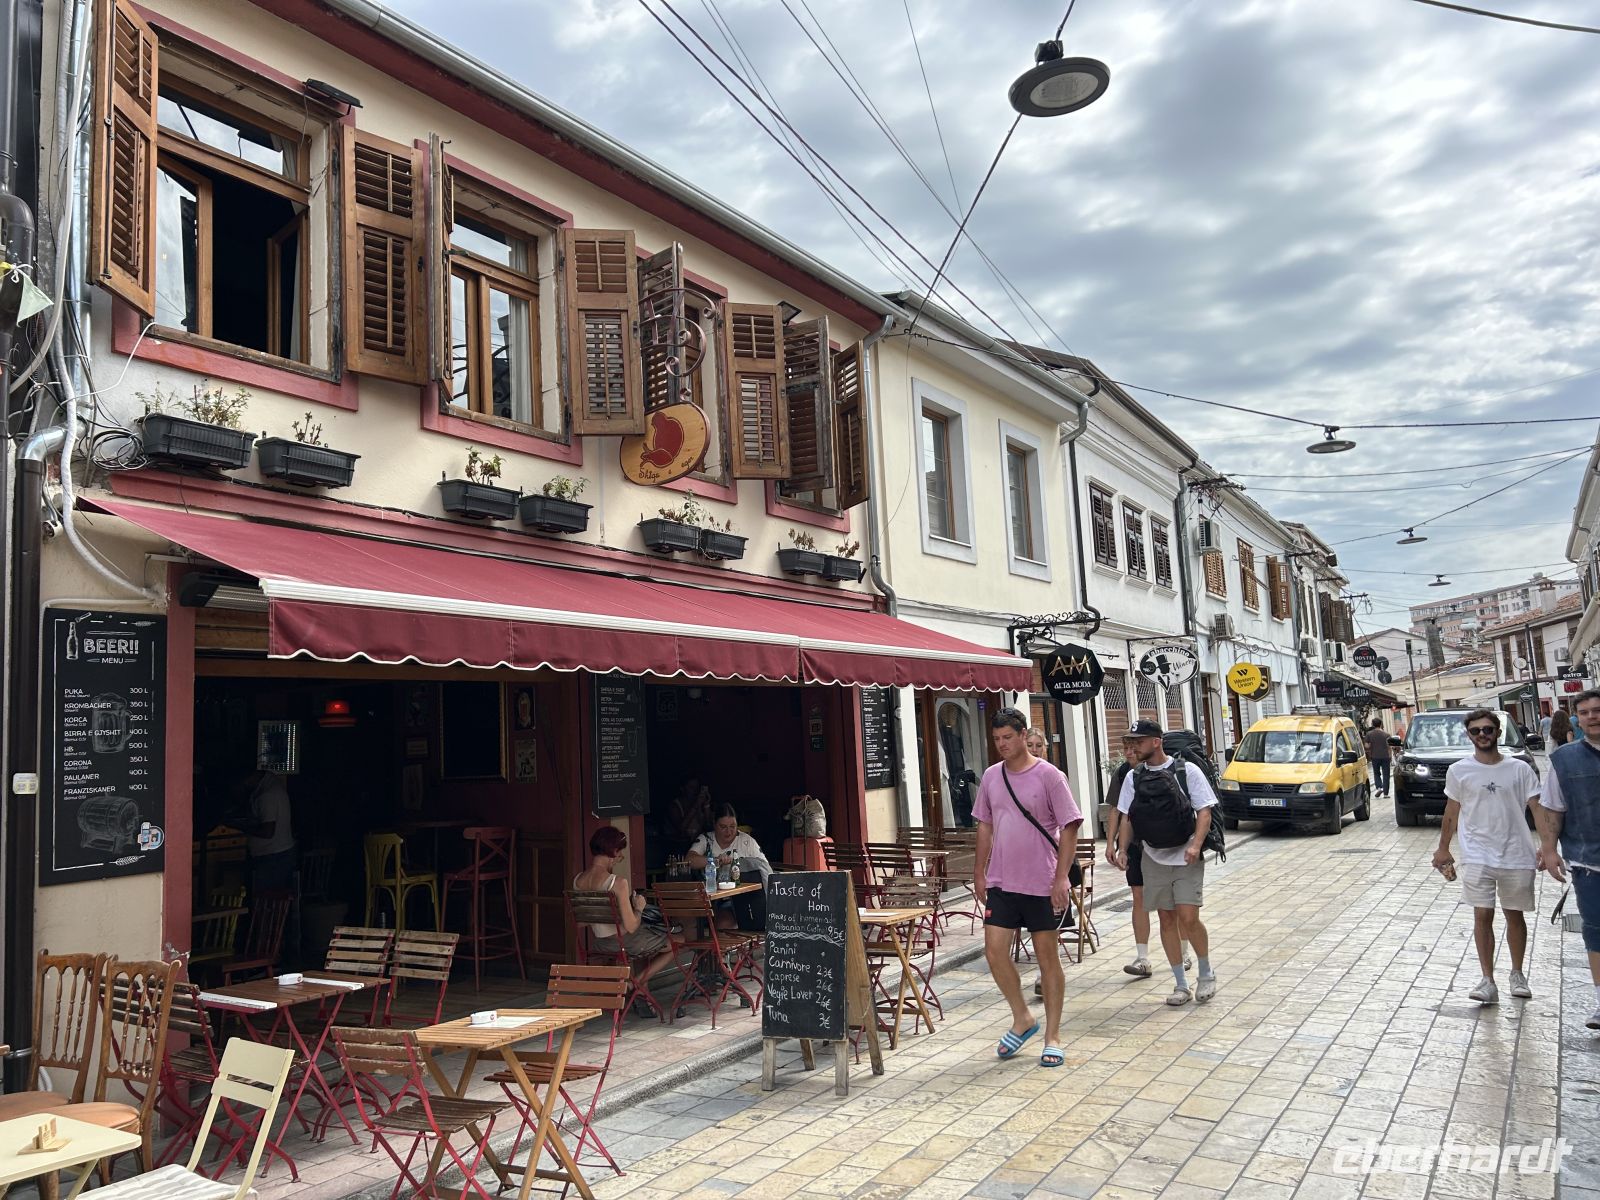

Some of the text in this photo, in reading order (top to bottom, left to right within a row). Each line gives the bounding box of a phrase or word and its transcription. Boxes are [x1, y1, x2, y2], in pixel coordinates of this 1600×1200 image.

[84, 638, 138, 654] BEER!!
[64, 786, 116, 795] FRANZISKANER
[774, 882, 822, 899] Taste of
[770, 941, 796, 954] Panini
[769, 971, 800, 984] Caprese
[791, 986, 812, 1000] Lover
[766, 1005, 790, 1024] Tuna
